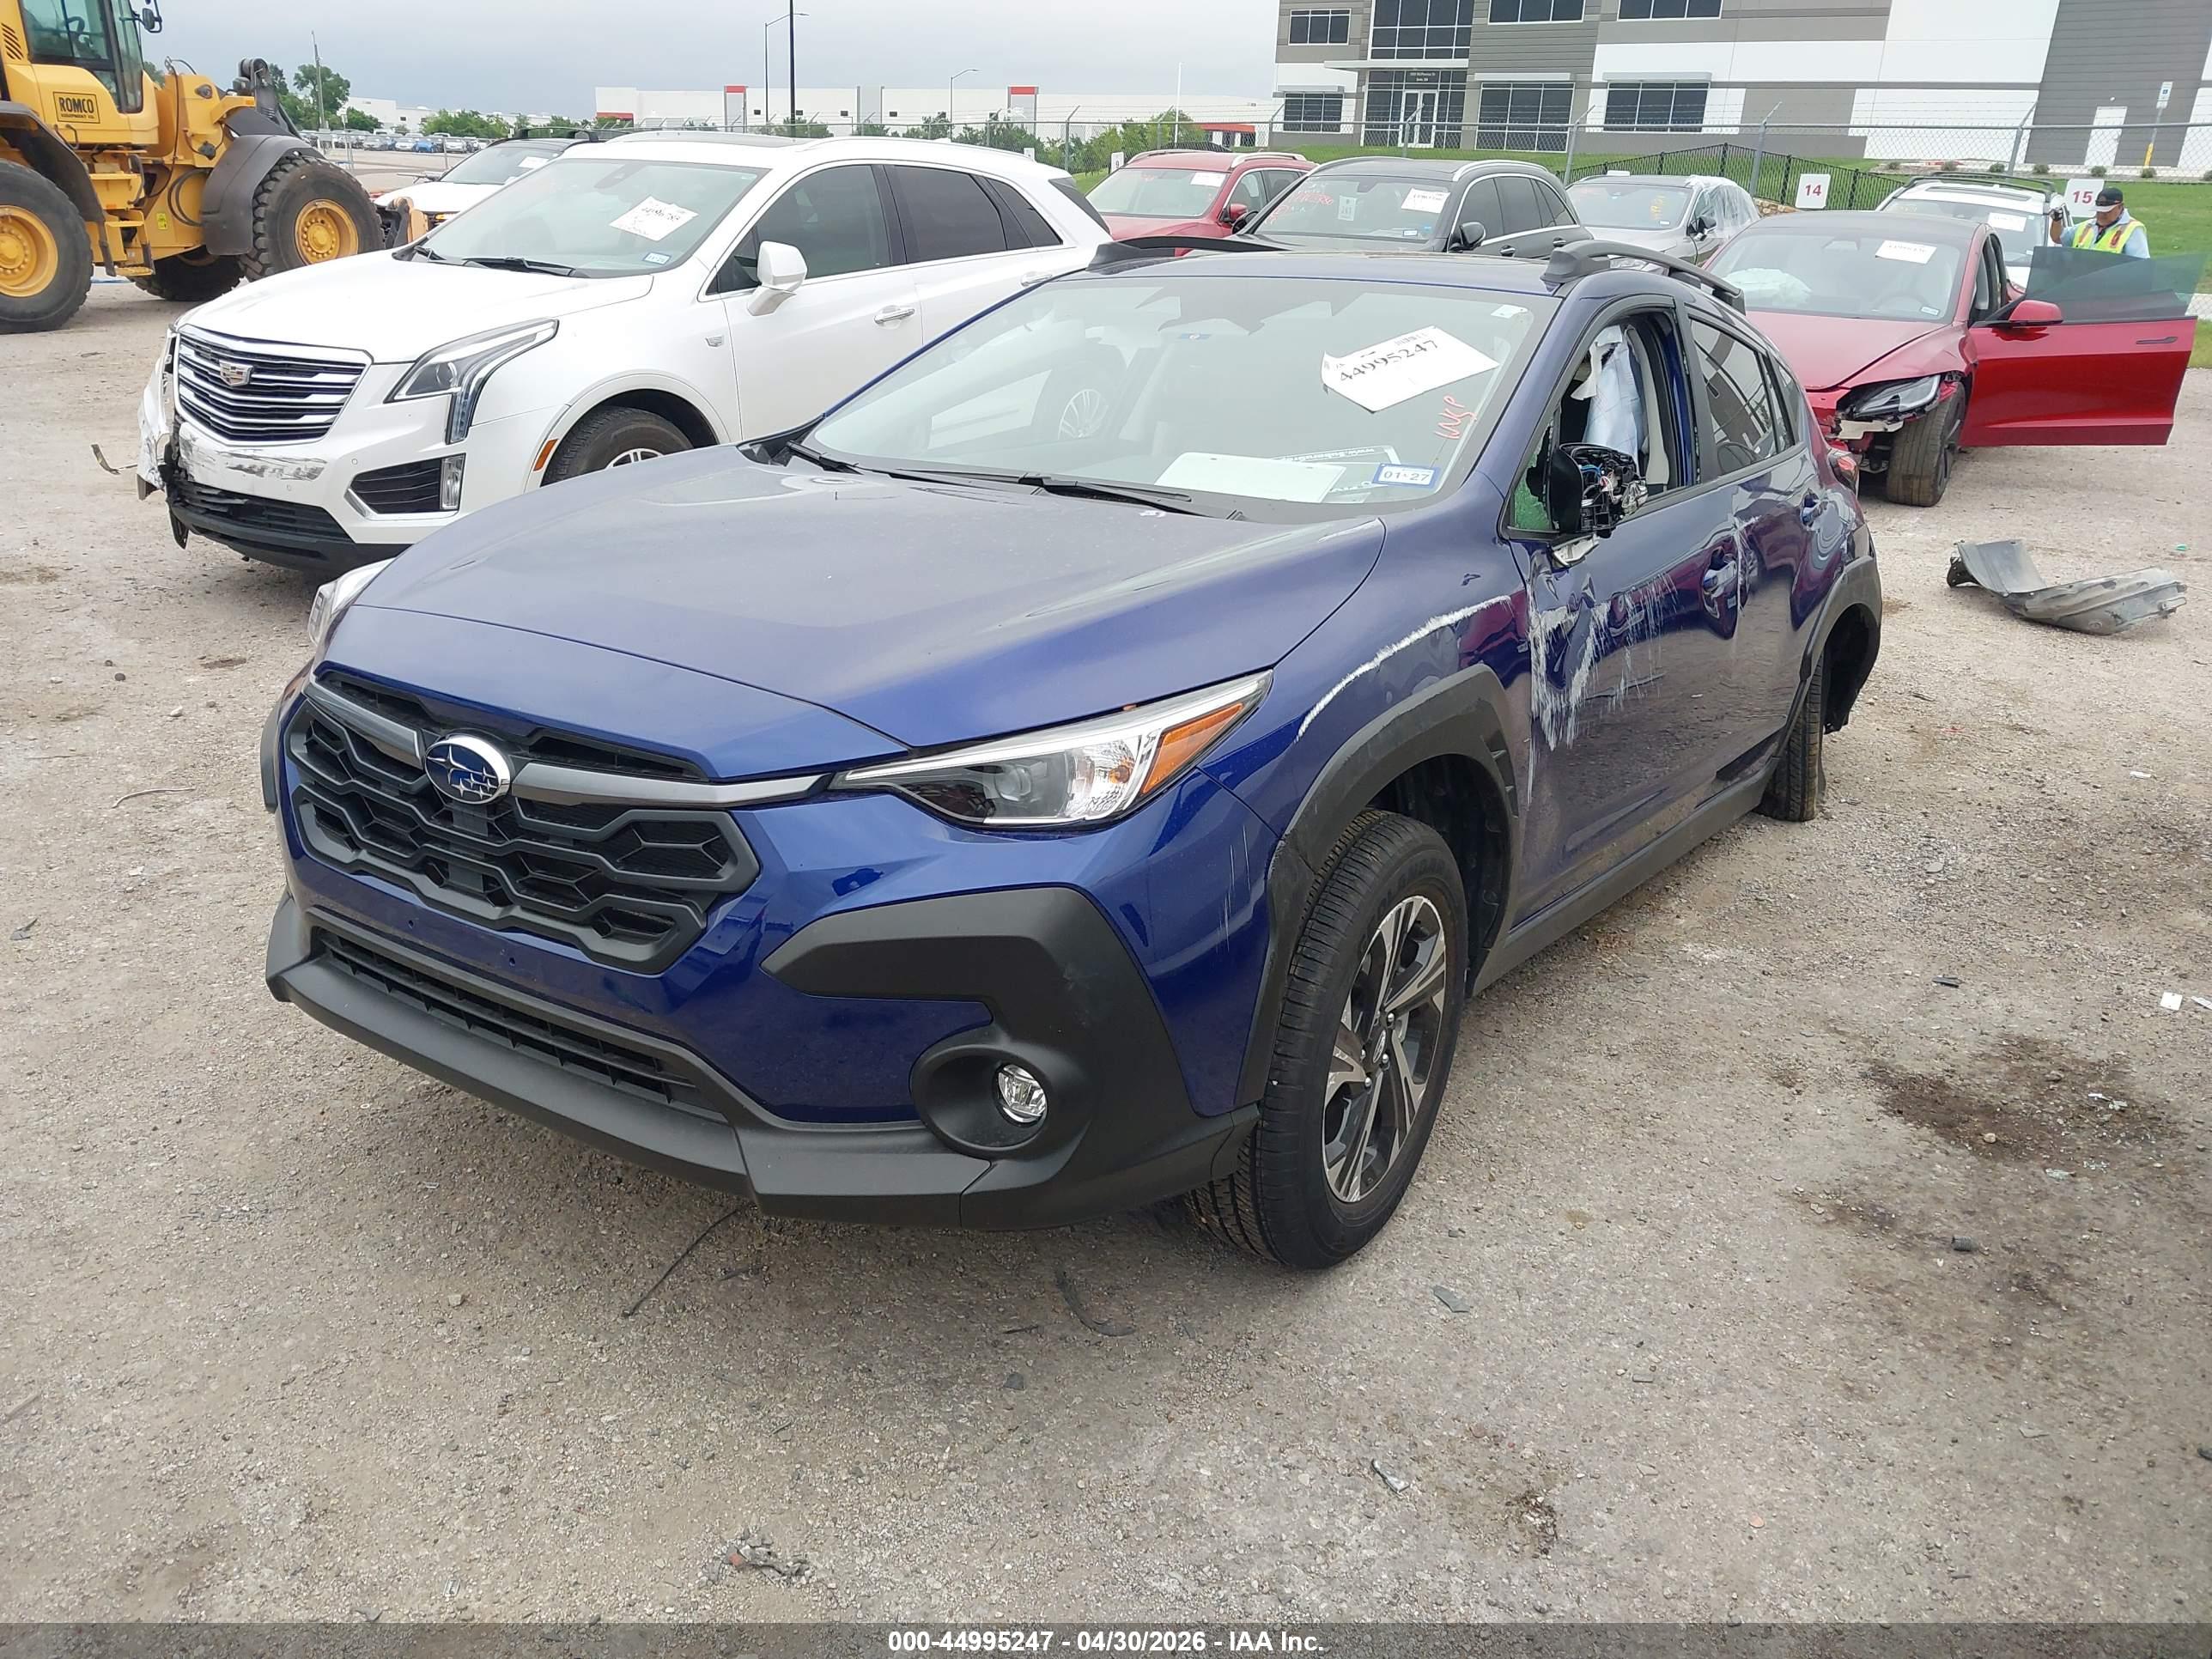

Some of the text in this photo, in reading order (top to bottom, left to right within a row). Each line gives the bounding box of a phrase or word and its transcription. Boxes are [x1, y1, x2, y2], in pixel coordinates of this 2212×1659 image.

[58, 97, 94, 113] ROMCO
[1805, 184, 1822, 197] 14
[2073, 190, 2094, 204] 15
[1340, 339, 1438, 381] 44995247
